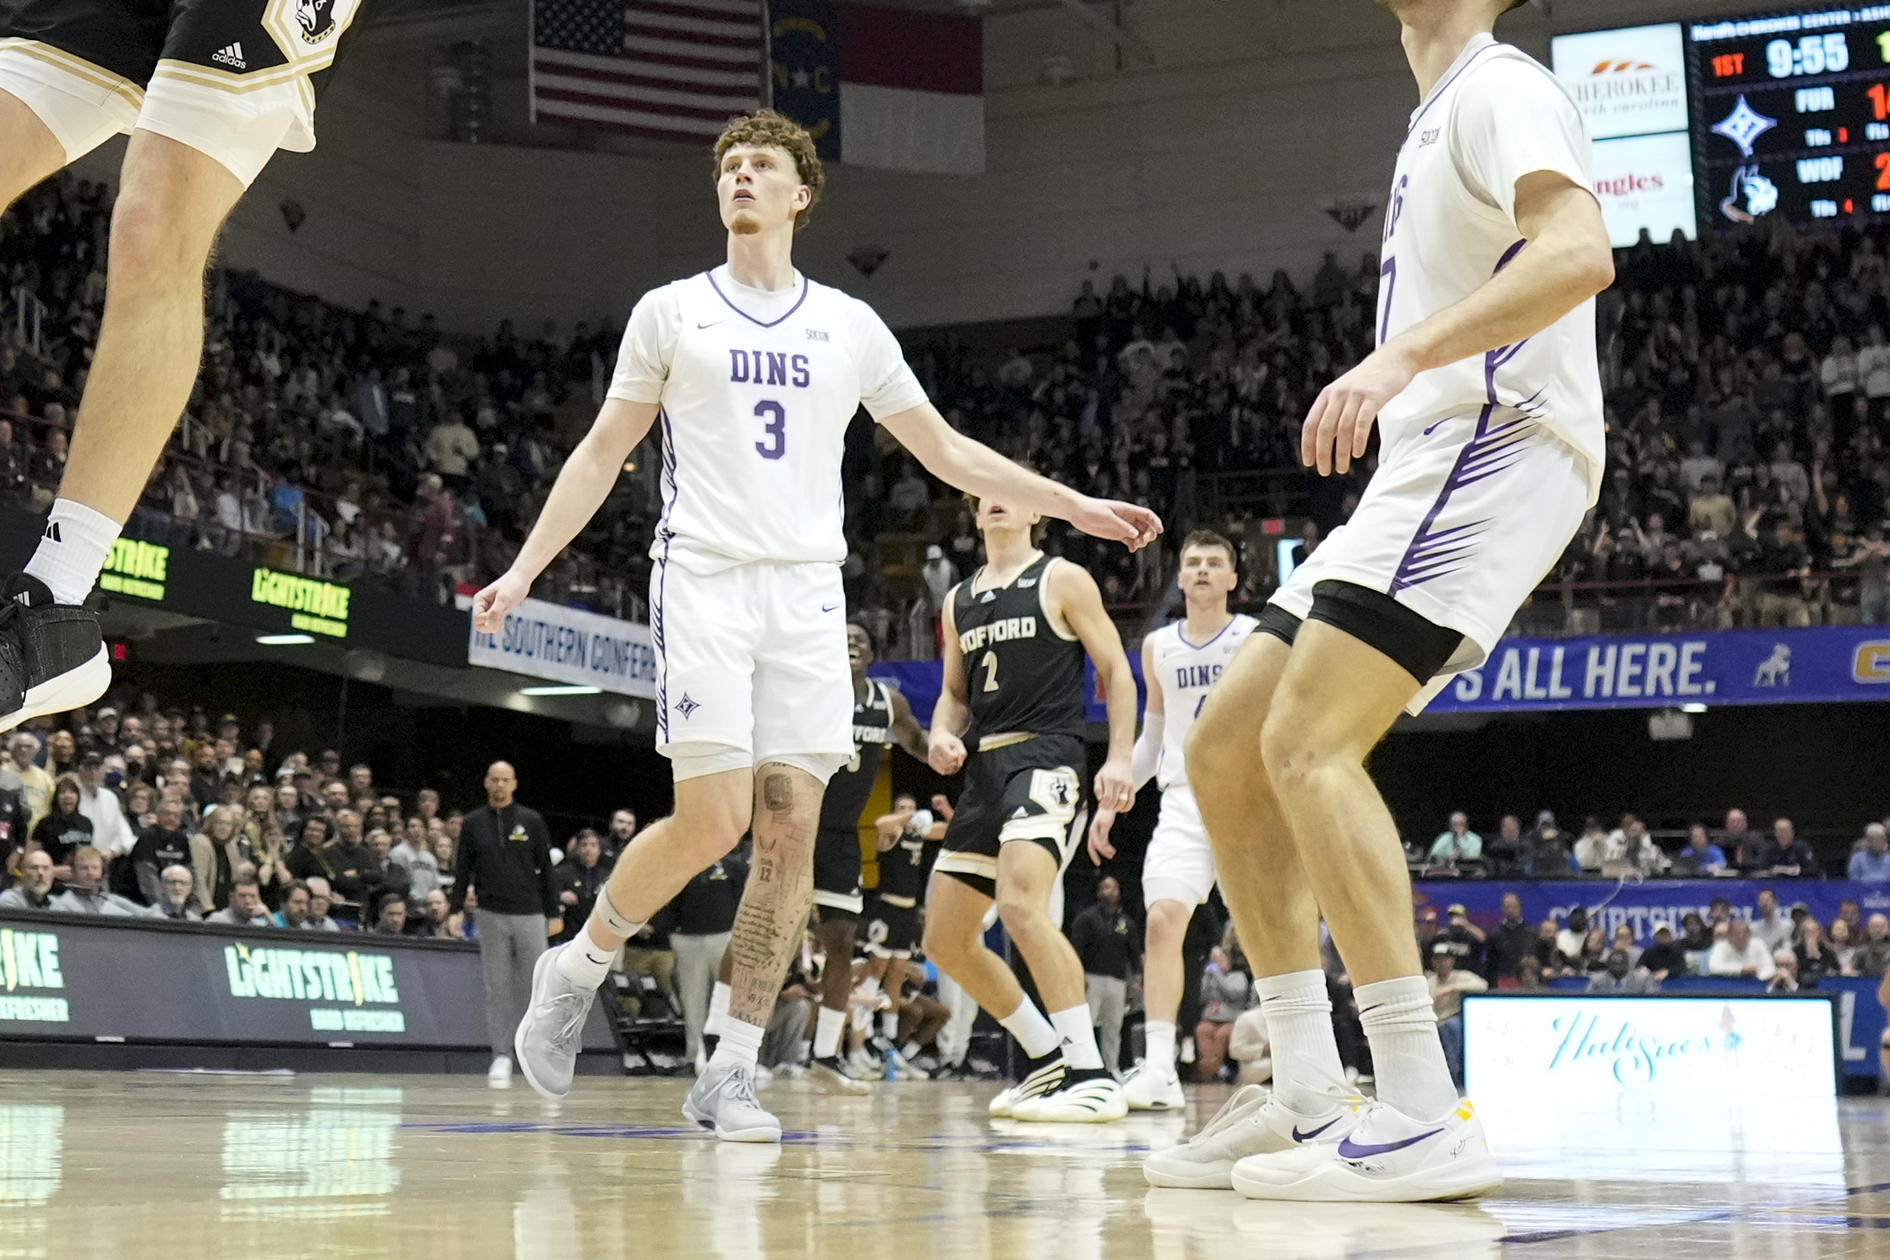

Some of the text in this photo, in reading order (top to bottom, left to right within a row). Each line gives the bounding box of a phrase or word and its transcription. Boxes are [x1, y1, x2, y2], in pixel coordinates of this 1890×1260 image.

[1712, 53, 1745, 77] 1ST
[1766, 32, 1850, 78] 9:55
[1795, 86, 1836, 114] FUR
[1796, 155, 1844, 184] WOF
[729, 348, 810, 388] DINS
[754, 399, 785, 461] 3
[103, 537, 170, 581] STRIKE
[501, 613, 587, 669] SOUTHERN
[981, 650, 1000, 693] 2
[1493, 646, 1573, 701] ALL
[1584, 641, 1717, 699] HERE.
